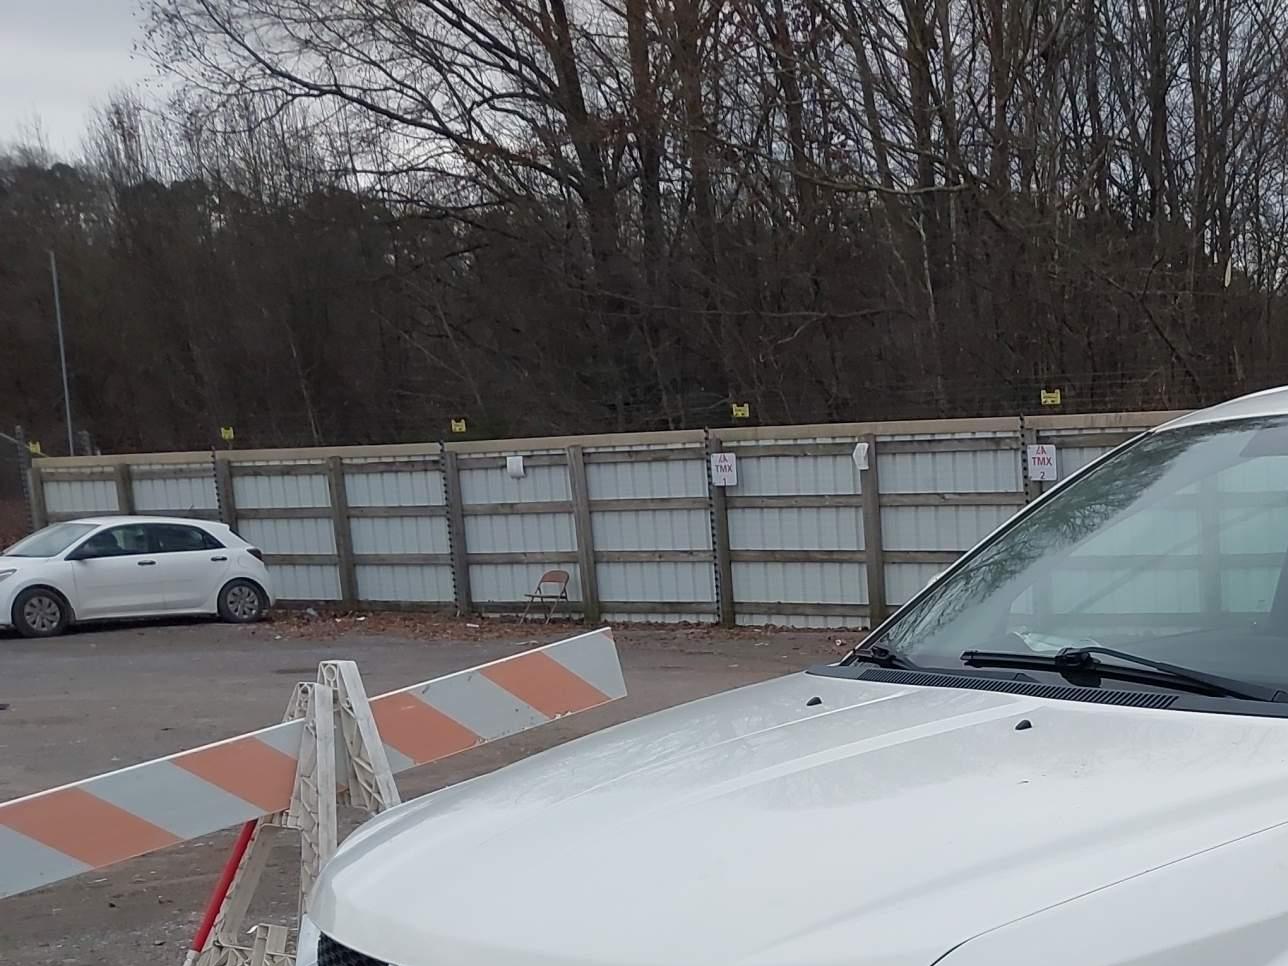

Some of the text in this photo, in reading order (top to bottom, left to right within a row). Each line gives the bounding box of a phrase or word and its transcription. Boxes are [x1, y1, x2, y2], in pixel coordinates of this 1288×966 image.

[1032, 457, 1052, 466] TMX
[714, 464, 733, 473] TMX
[1040, 472, 1046, 480] 2
